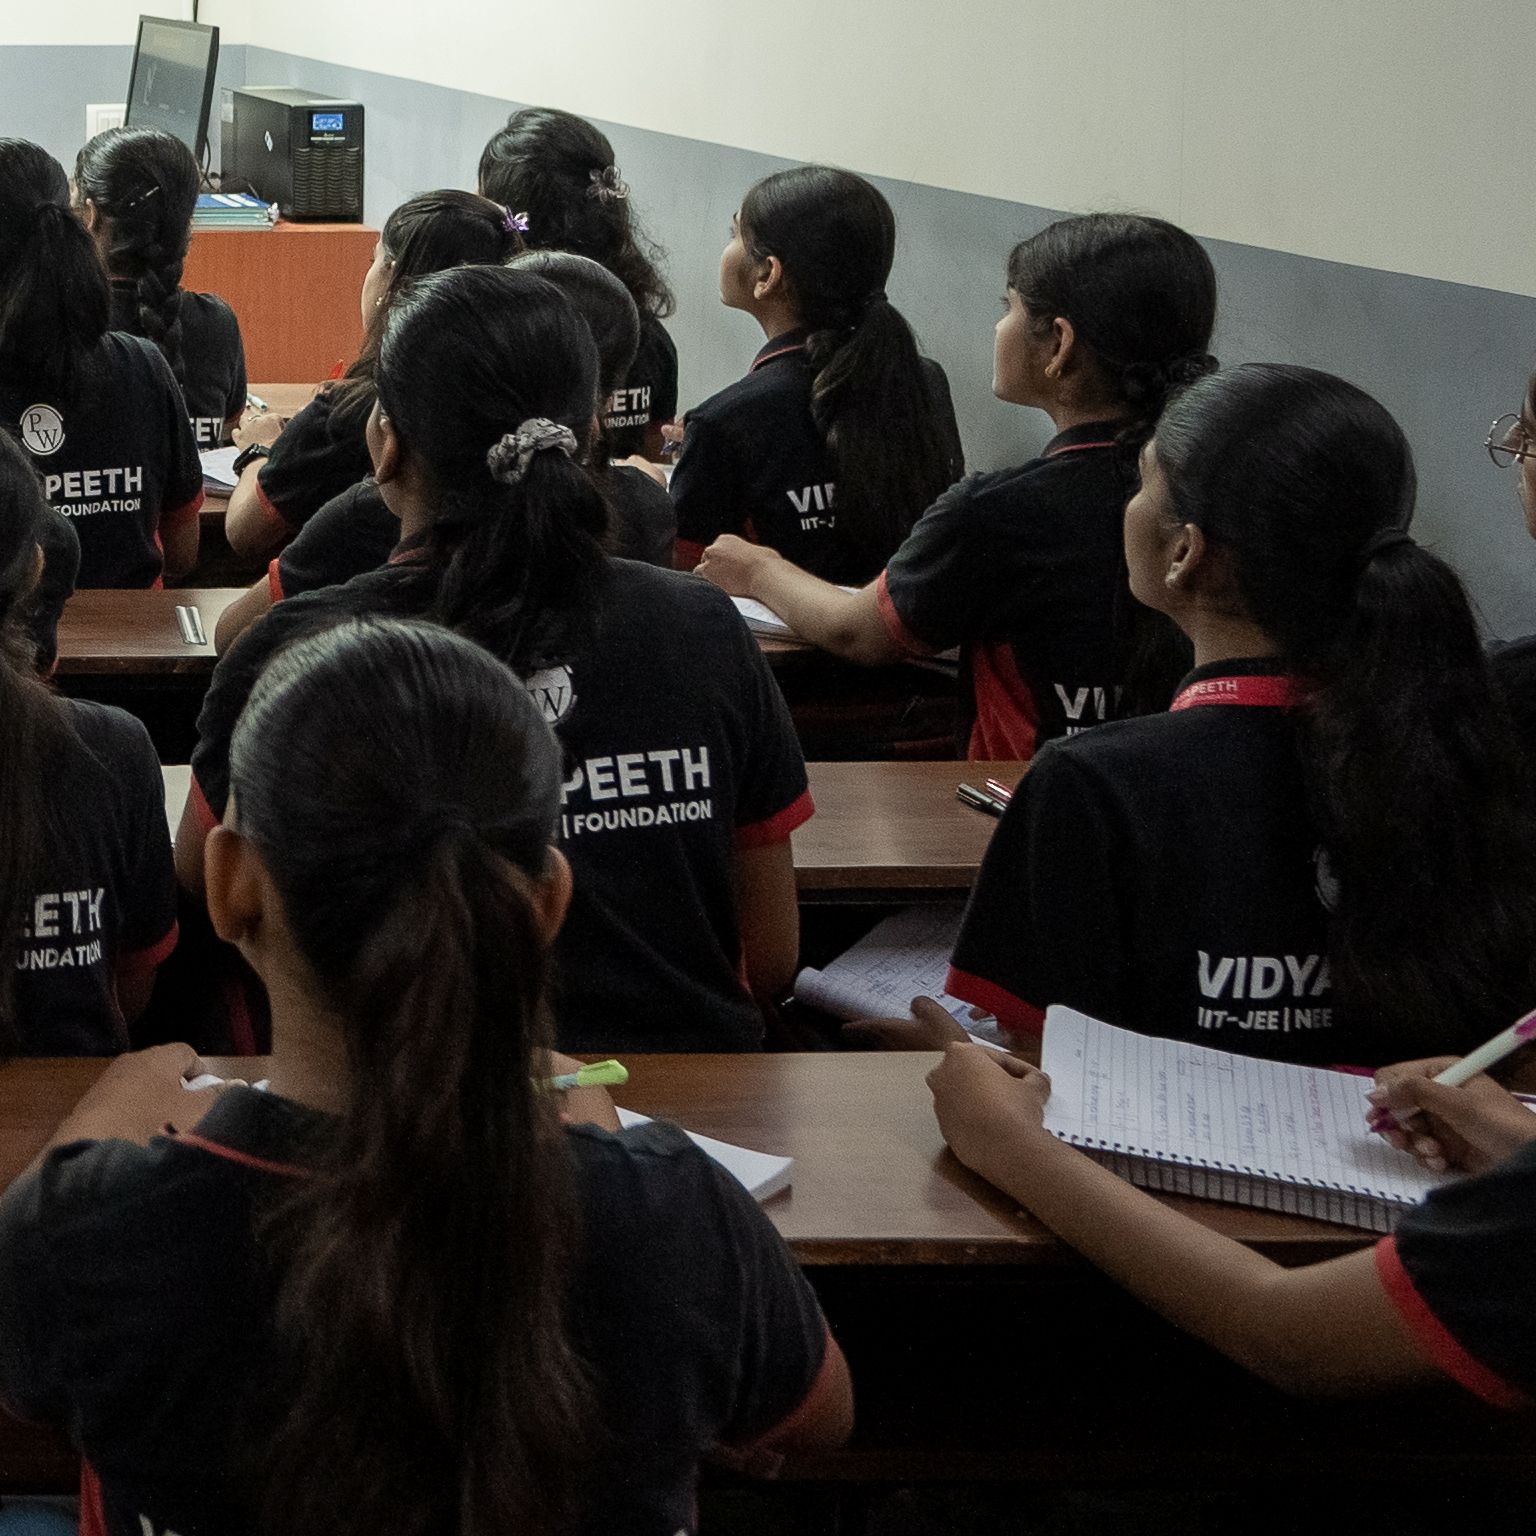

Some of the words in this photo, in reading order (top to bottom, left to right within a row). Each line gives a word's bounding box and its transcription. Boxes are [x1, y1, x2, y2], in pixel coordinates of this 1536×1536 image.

[45, 466, 143, 500] PEETH
[800, 515, 835, 531] IIT-J
[560, 746, 711, 805] PEETH
[573, 799, 712, 835] FOUNDATION
[1198, 1006, 1279, 1031] IIT-JEE
[1294, 1008, 1333, 1031] NEE
